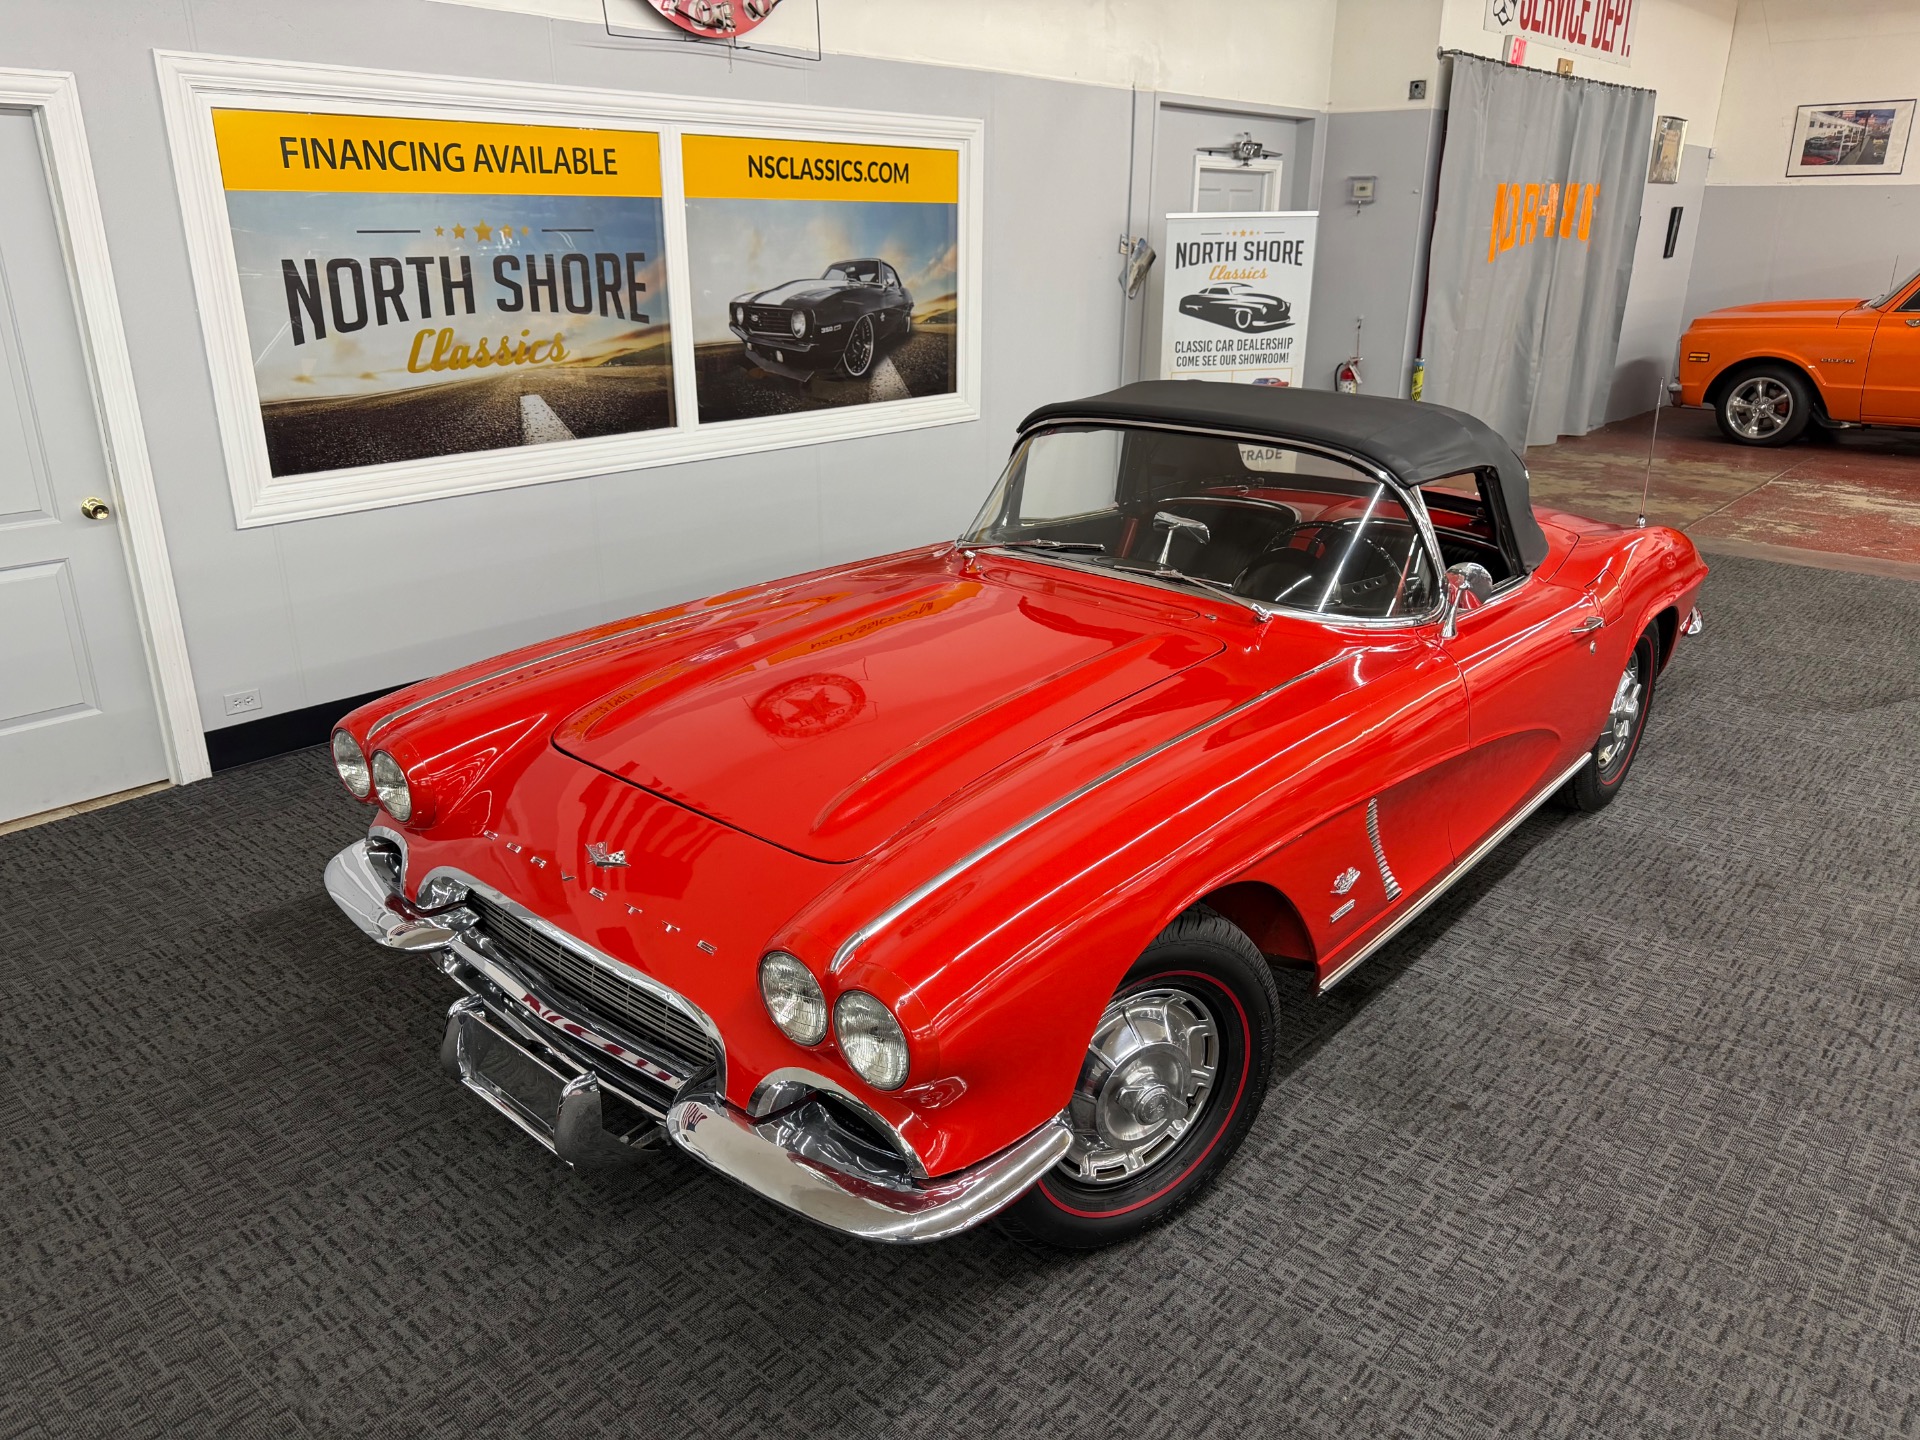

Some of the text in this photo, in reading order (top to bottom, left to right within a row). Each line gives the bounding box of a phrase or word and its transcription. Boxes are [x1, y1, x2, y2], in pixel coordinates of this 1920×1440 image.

[279, 136, 618, 176] FINANCING AVAILABLE
[747, 154, 910, 184] NSCLASSICS.COM
[1175, 240, 1304, 269] NORTH SHORE
[1208, 265, 1268, 281] Classics
[280, 252, 650, 346] NORTH SHORE
[407, 327, 570, 373] Classics
[1174, 337, 1293, 353] CLASSIC CAR DEALERSHIP
[1176, 352, 1289, 367] COME SEE OUR SHOWROOM!
